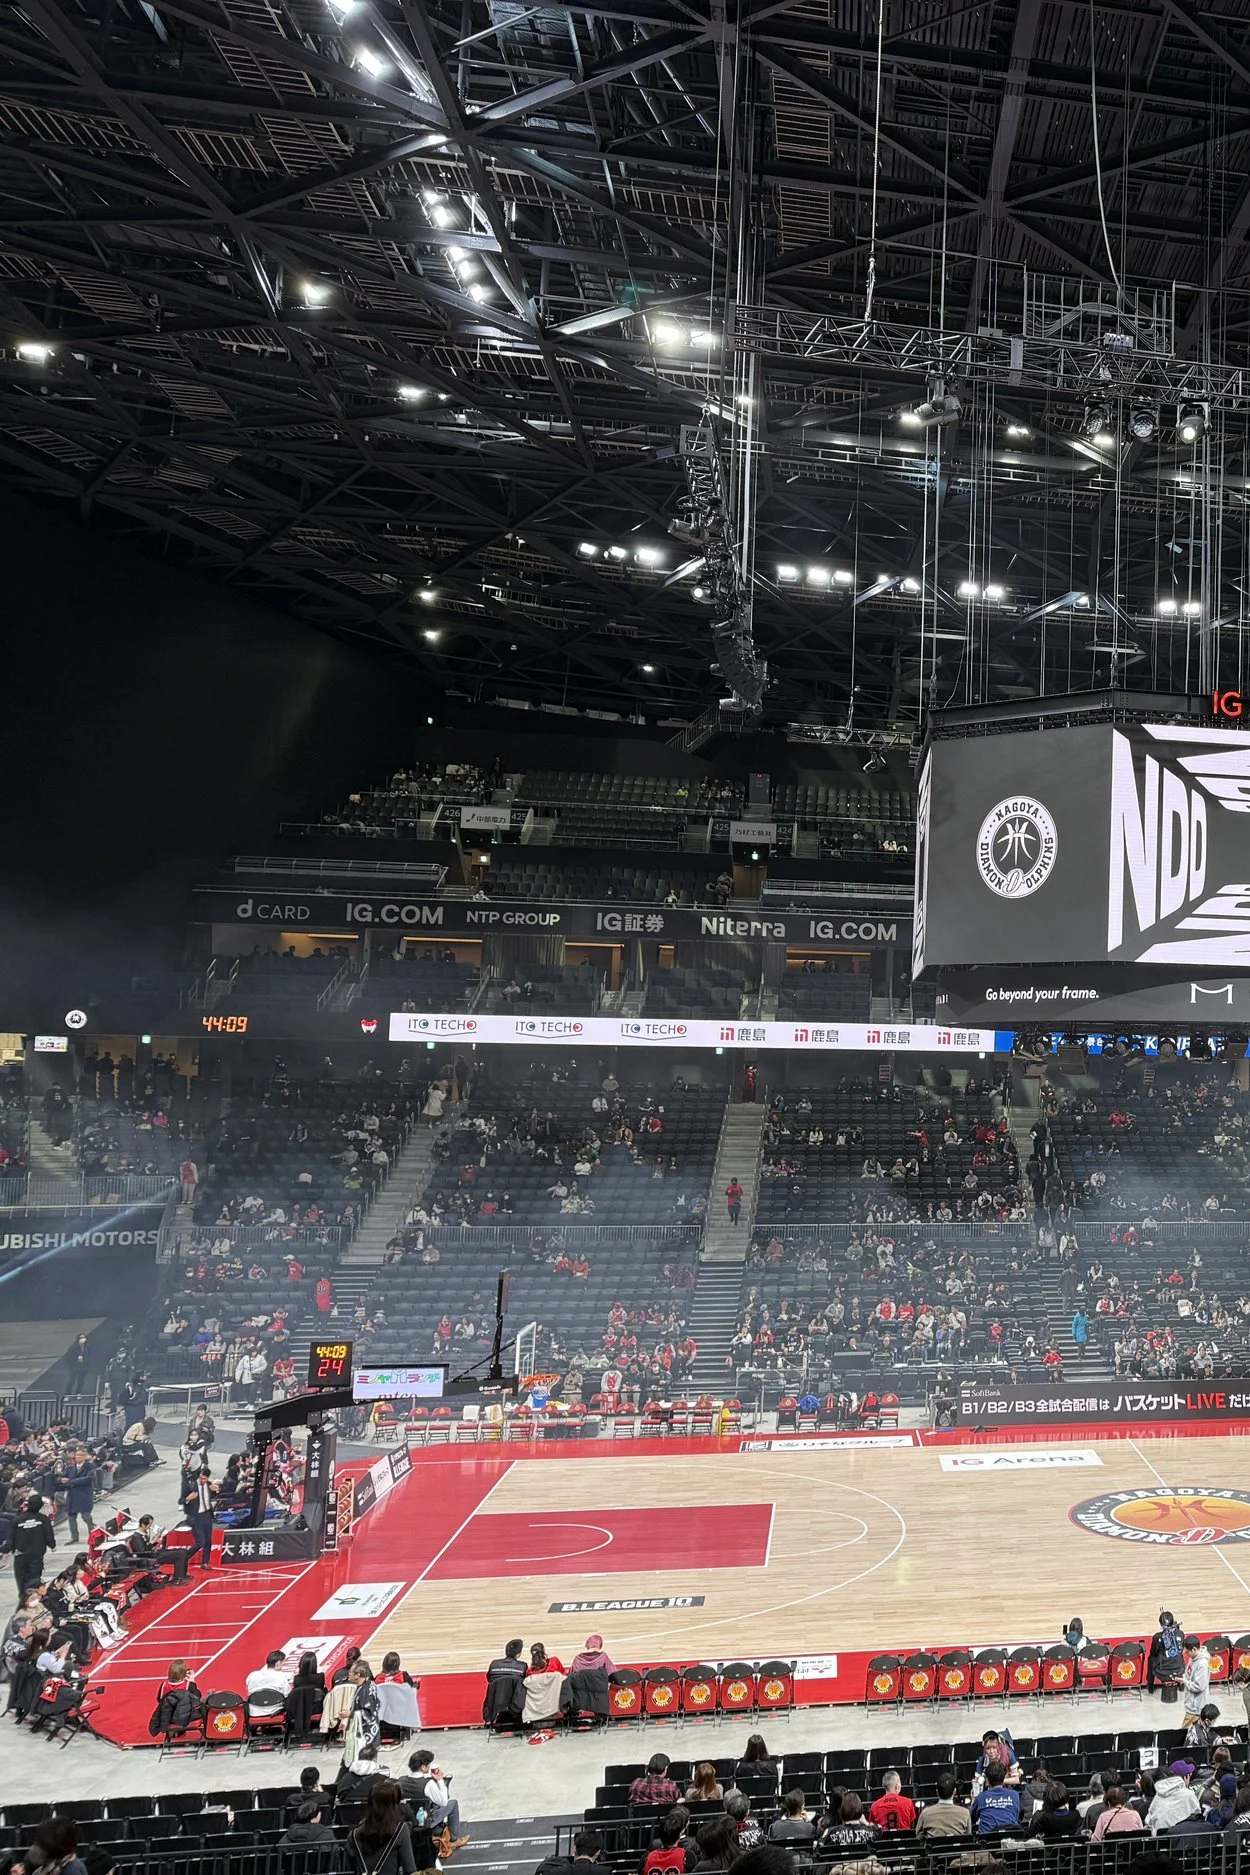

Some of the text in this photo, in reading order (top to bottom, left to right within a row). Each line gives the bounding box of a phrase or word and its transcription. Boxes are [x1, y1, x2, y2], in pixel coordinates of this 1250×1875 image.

[1212, 691, 1242, 717] IG
[444, 809, 460, 817] 426
[995, 802, 1039, 821] NAGOYA
[257, 905, 310, 920] CARD
[346, 903, 444, 925] IG.COM
[466, 911, 561, 926] NTP GROUP
[596, 912, 665, 933] IG証券
[701, 916, 786, 938] Niterra
[809, 920, 897, 941] IG.COM
[986, 986, 1100, 1004] Go beyond your frame.
[202, 1015, 248, 1033] 44:09
[737, 1028, 766, 1041] 鹿島
[811, 1029, 839, 1043] 鹿島
[883, 1030, 910, 1044] 鹿島
[953, 1032, 980, 1046] 鹿島
[71, 1230, 158, 1247] MOTORS
[316, 1345, 347, 1358] 44:09
[317, 1360, 344, 1377] 24
[971, 1389, 1001, 1397] SoftBank
[952, 1455, 1085, 1466] IG Arena
[1110, 1487, 1235, 1501] NAGOYA
[221, 1541, 274, 1556] 大林組
[561, 1599, 663, 1611] B.LEAGUE
